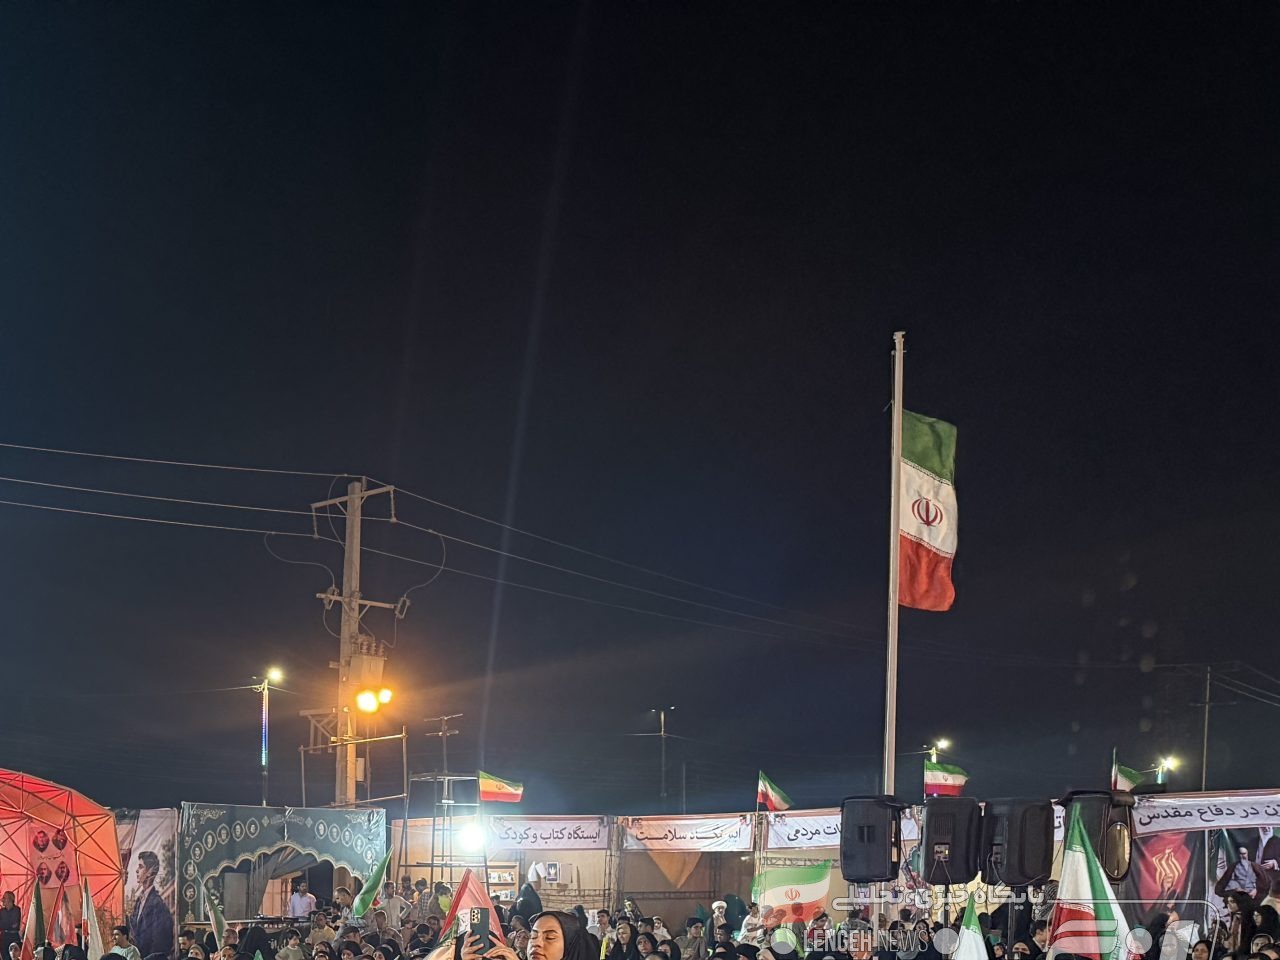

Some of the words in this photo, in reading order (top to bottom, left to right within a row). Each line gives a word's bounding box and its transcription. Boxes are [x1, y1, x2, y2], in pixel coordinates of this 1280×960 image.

[1138, 807, 1193, 826] مقدس
[1197, 804, 1235, 823] دفاع
[1239, 805, 1260, 819] در
[499, 827, 531, 844] کودک
[531, 833, 539, 844] و
[540, 827, 568, 845] کتاب
[567, 826, 601, 845] ایستگاه
[635, 828, 687, 842] سلامت
[787, 828, 821, 842] مردمی
